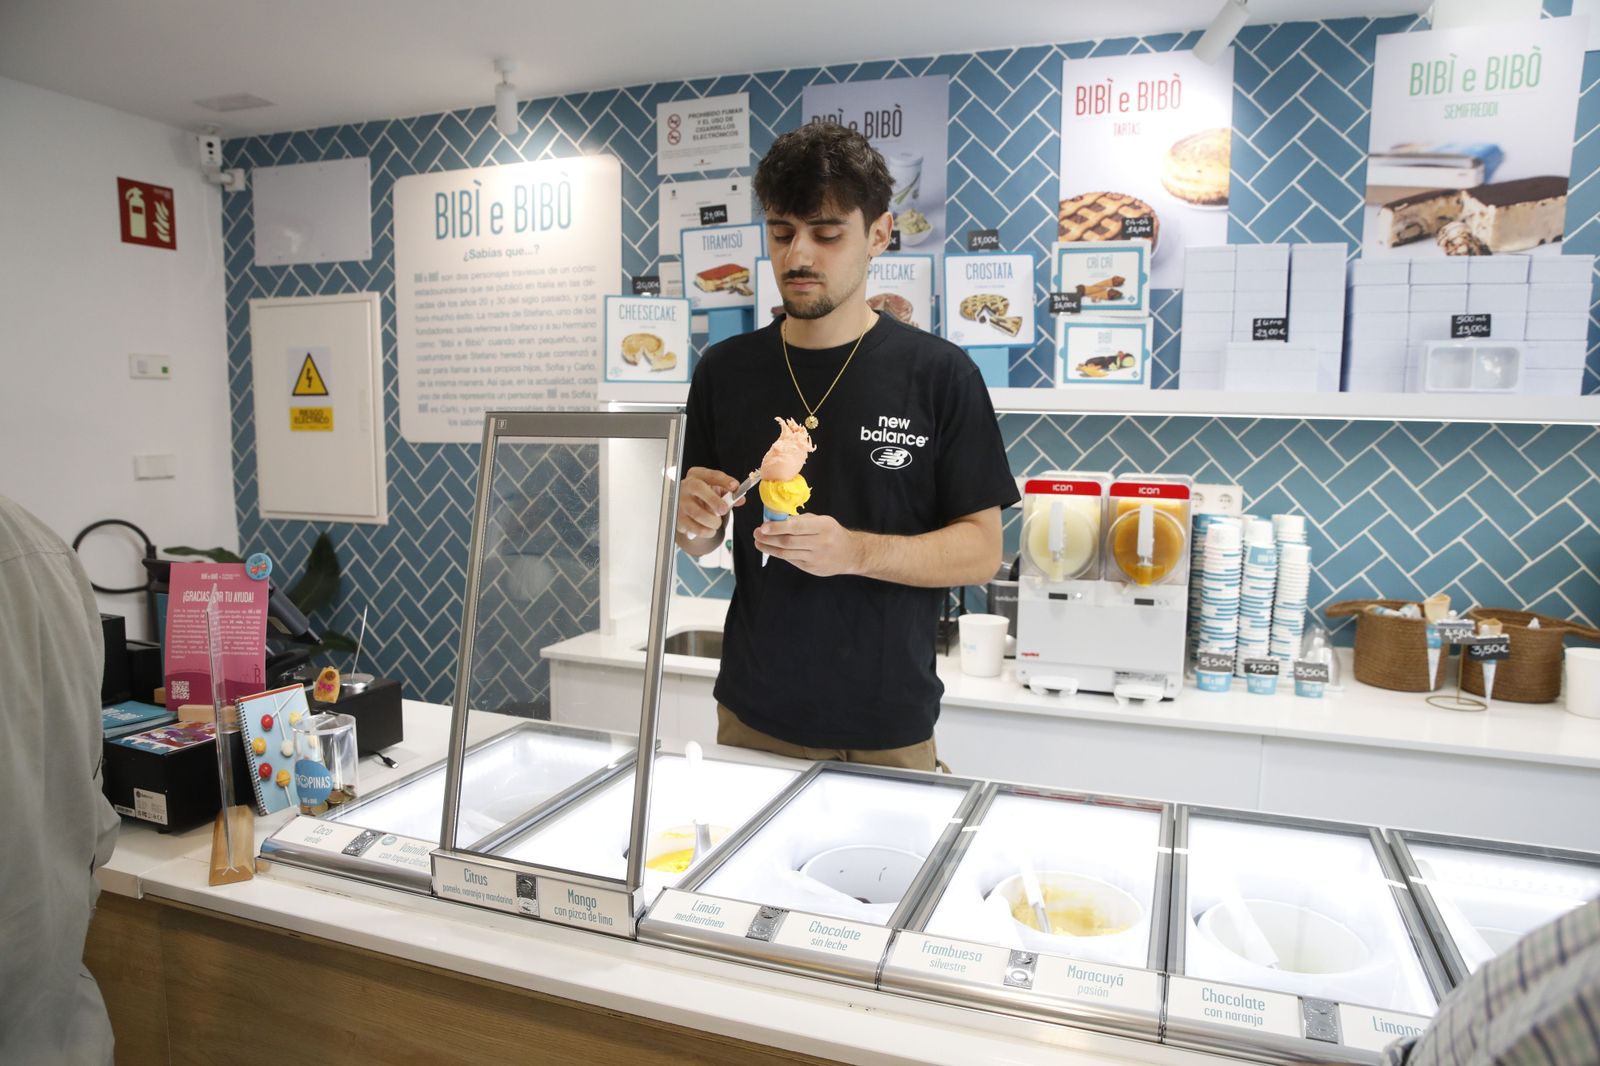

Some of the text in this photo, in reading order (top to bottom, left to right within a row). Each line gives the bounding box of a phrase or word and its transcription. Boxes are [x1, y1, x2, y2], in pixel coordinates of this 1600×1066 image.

[1409, 45, 1542, 96] BIBÌ e BIBÒ
[1076, 73, 1182, 116] BIBÌ e BIBÒ
[688, 108, 743, 119] PROHIBIDO FUMAR
[1444, 101, 1498, 120] SEMIFREDDI
[695, 123, 735, 133] CIGARRILLOS
[864, 103, 903, 139] BIBÒ
[435, 171, 572, 240] BIBÌ e BIBÒ
[966, 262, 1013, 280] CROSTATA
[618, 304, 677, 322] CHEESECAKE
[878, 415, 911, 430] new
[860, 426, 926, 448] balance
[225, 591, 233, 602] TU
[233, 591, 255, 603] AYUDA!
[1470, 644, 1510, 656] 3,50€
[463, 868, 488, 887] Citrus
[567, 888, 597, 911] Mango
[691, 899, 721, 915] Limón
[554, 906, 613, 926] con pizca de lima
[674, 911, 725, 929] mediterráneo
[808, 920, 861, 941] Chocolate
[810, 936, 848, 951] sin leche
[921, 940, 983, 963] Frambuesa
[929, 957, 967, 973] silvestre
[1067, 964, 1124, 988] Maracuyá
[1077, 983, 1109, 998] pasión
[1201, 987, 1265, 1011] Chocolate
[1204, 1005, 1264, 1028] con naranja
